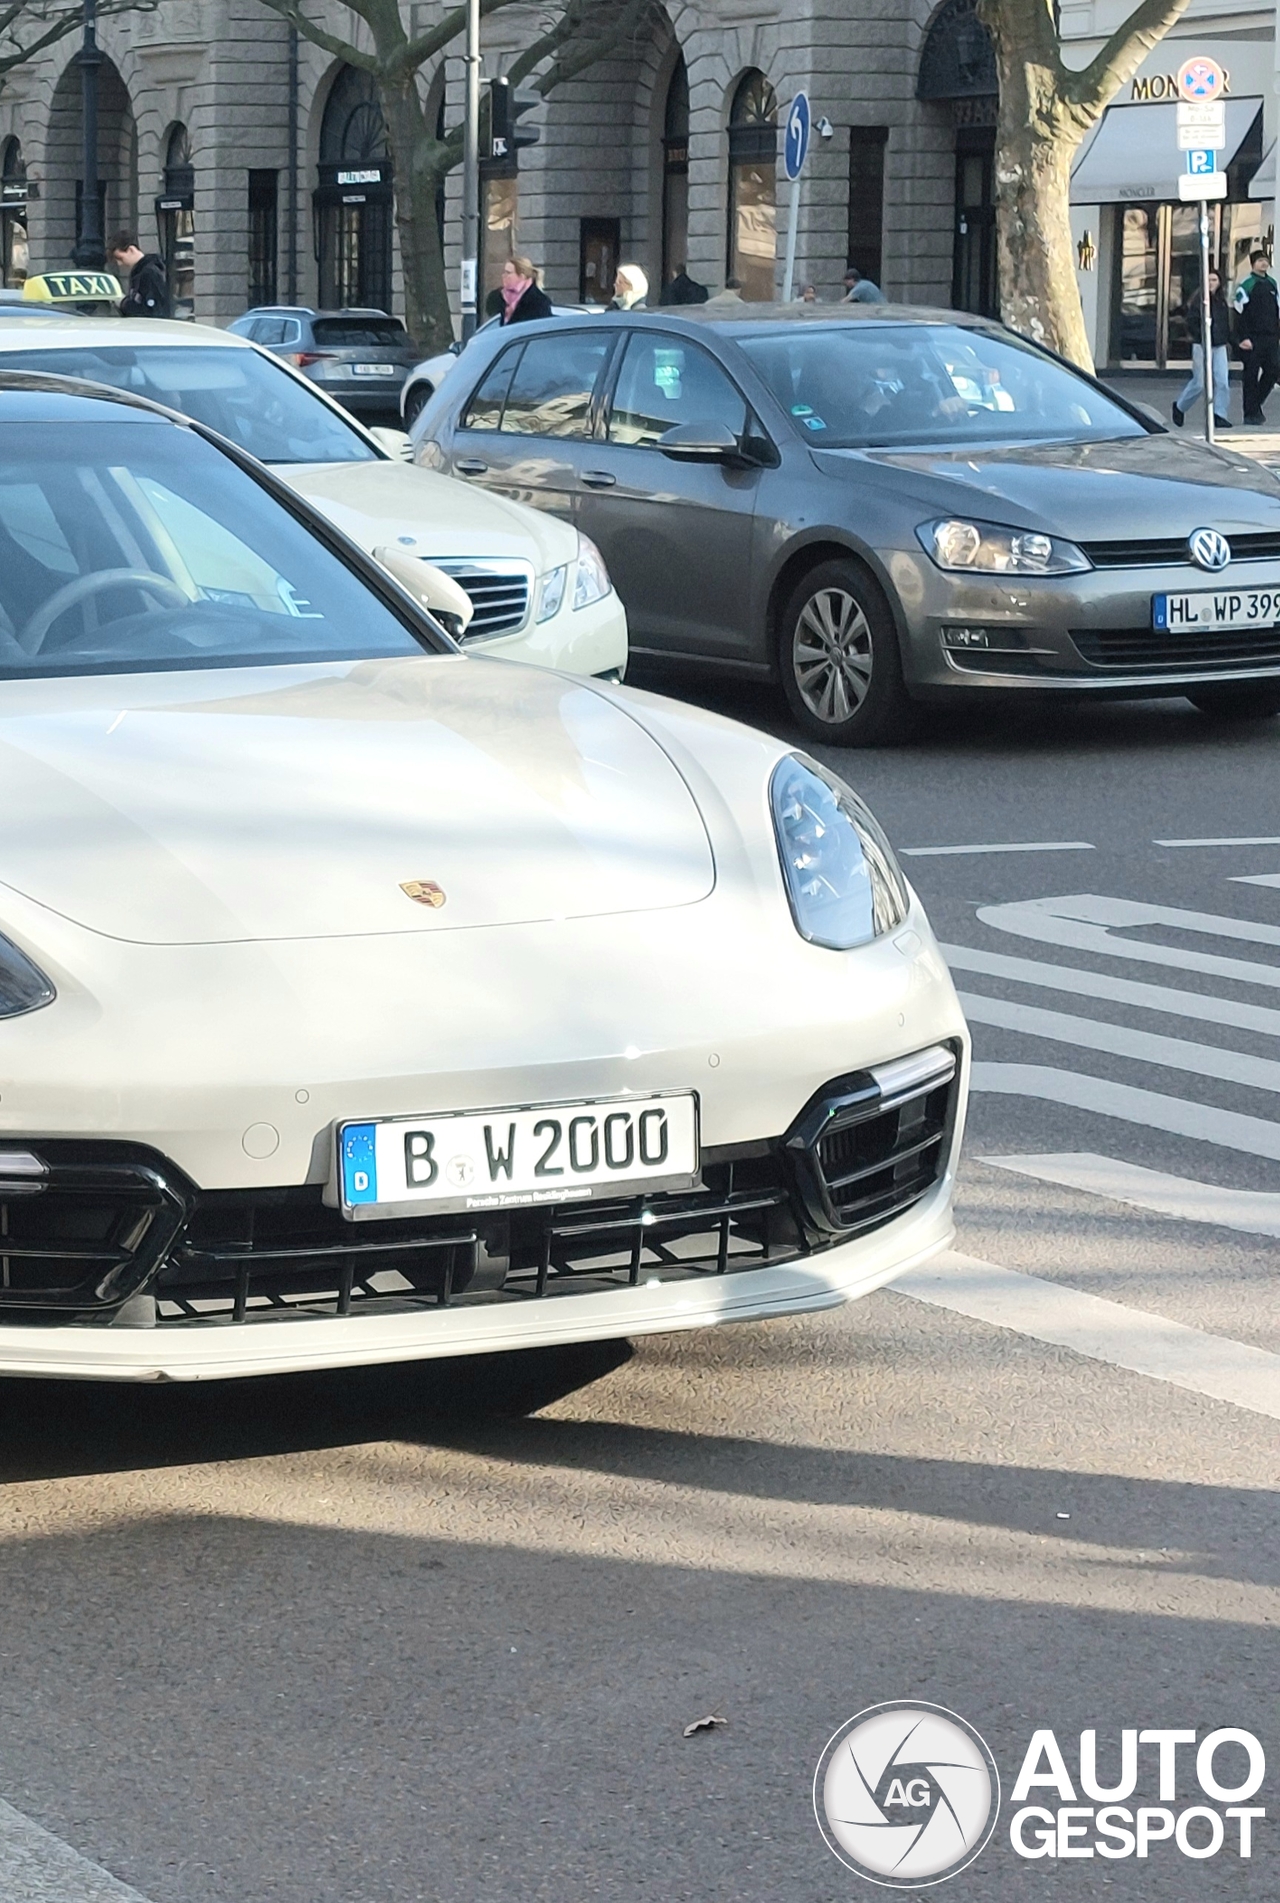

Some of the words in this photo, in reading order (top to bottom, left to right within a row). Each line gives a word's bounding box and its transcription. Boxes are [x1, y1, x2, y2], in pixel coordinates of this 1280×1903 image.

[1131, 69, 1231, 100] MONR
[1191, 151, 1208, 174] P
[49, 277, 111, 295] TAXI
[1170, 598, 1198, 623] HL
[1214, 595, 1241, 621] WP
[1247, 593, 1280, 619] 399
[404, 1130, 439, 1189] B
[483, 1123, 517, 1182] W
[533, 1108, 669, 1178] 2000
[353, 1171, 369, 1191] D
